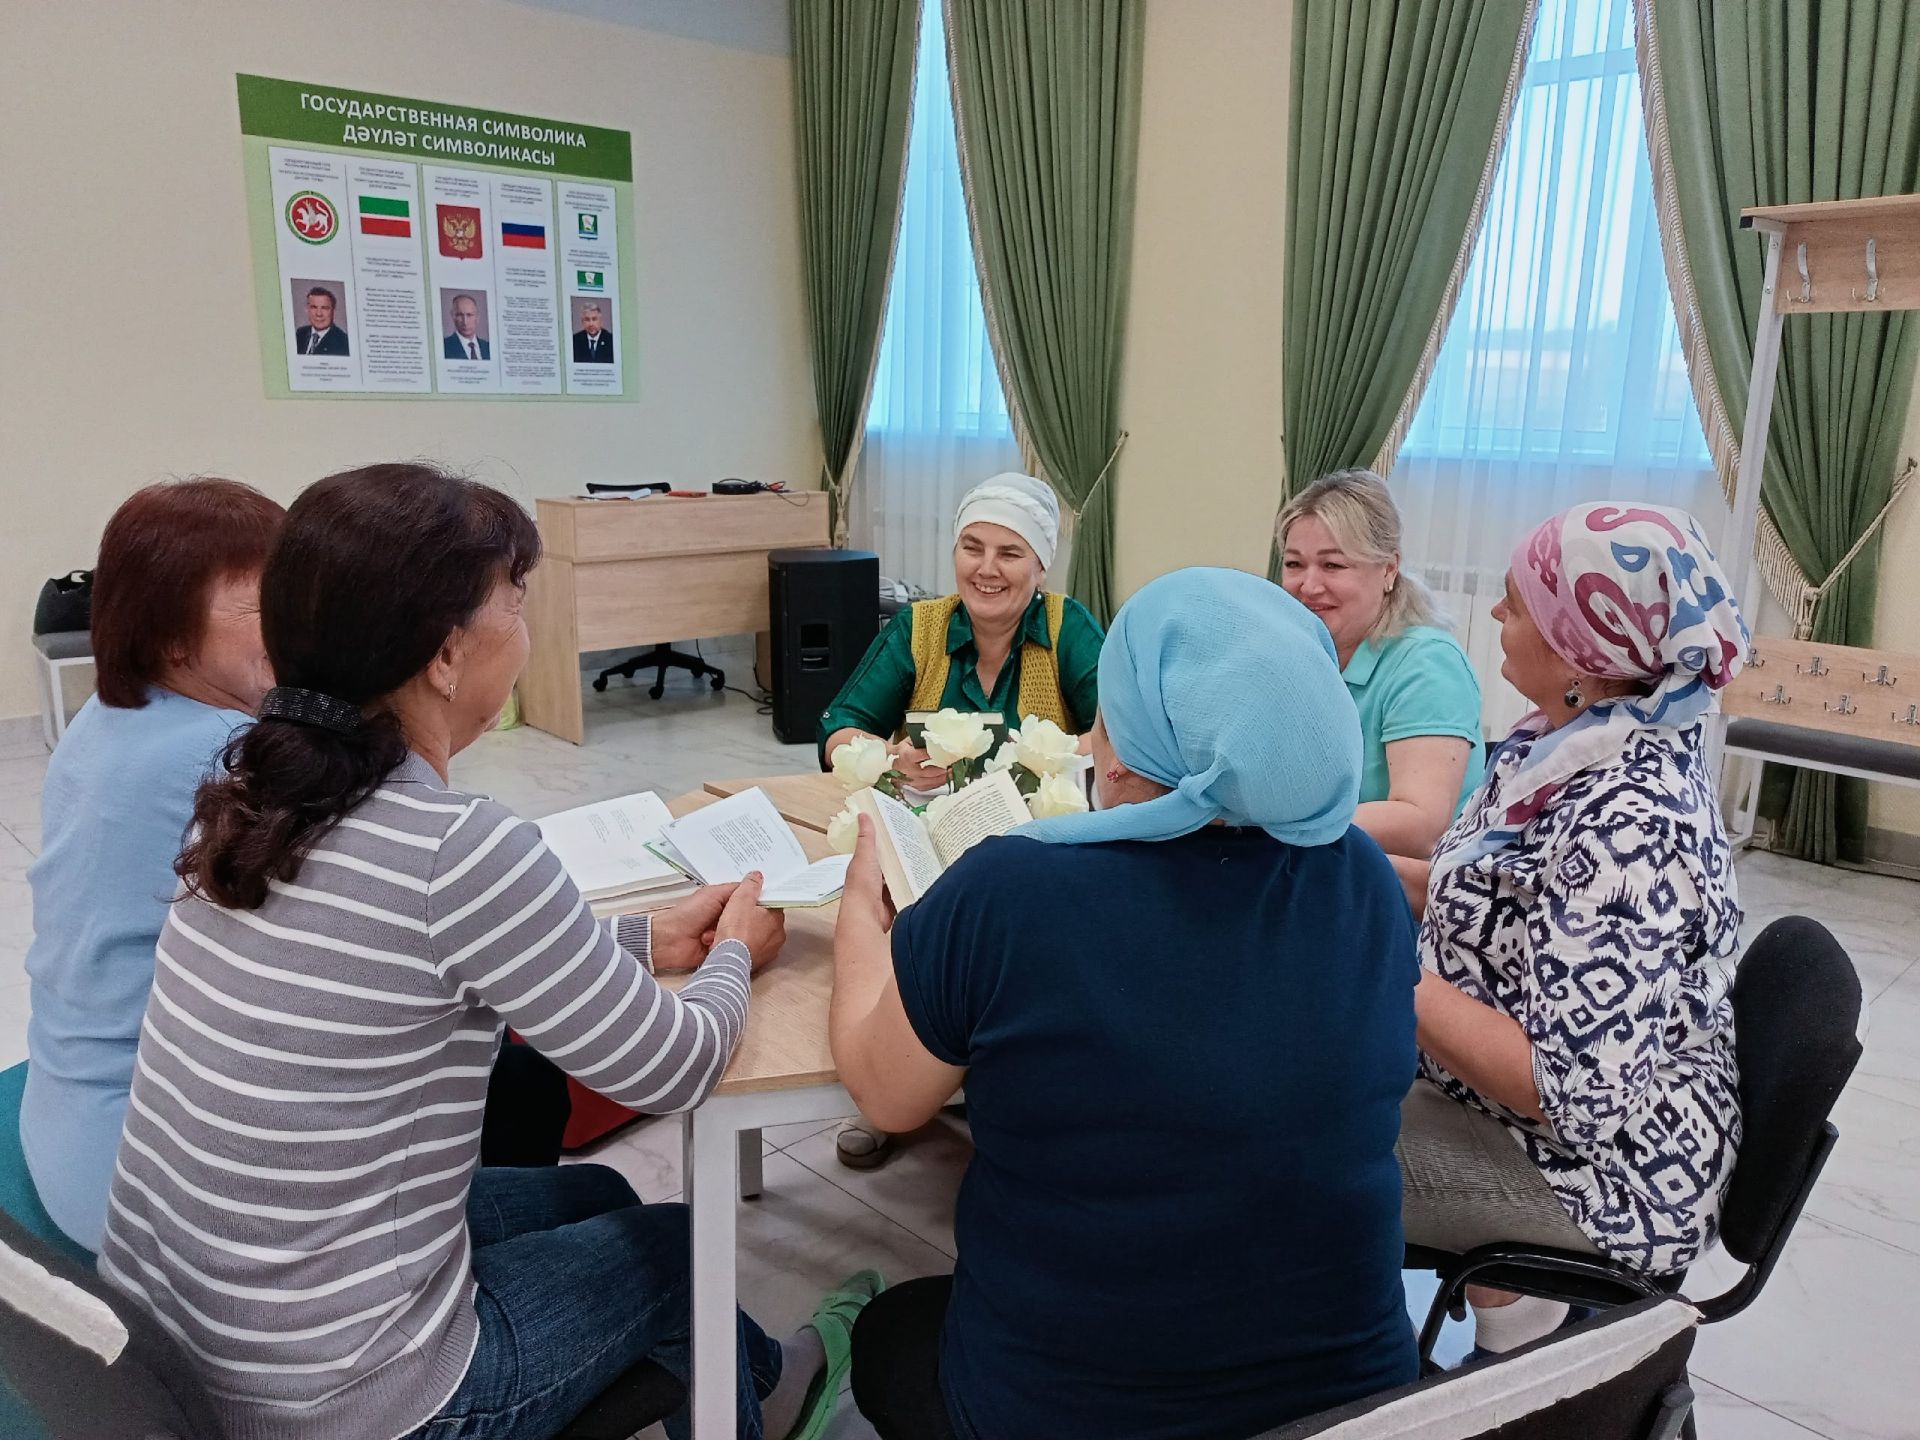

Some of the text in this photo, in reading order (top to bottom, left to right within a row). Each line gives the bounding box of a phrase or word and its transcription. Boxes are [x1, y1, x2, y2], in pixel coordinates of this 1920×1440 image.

[300, 92, 587, 148] ГОСУДАРСТВЕННАЯ СИМВОЛИКА
[342, 124, 555, 166] ДӘҮЛӘТ СИМВОЛИКАСЫ
